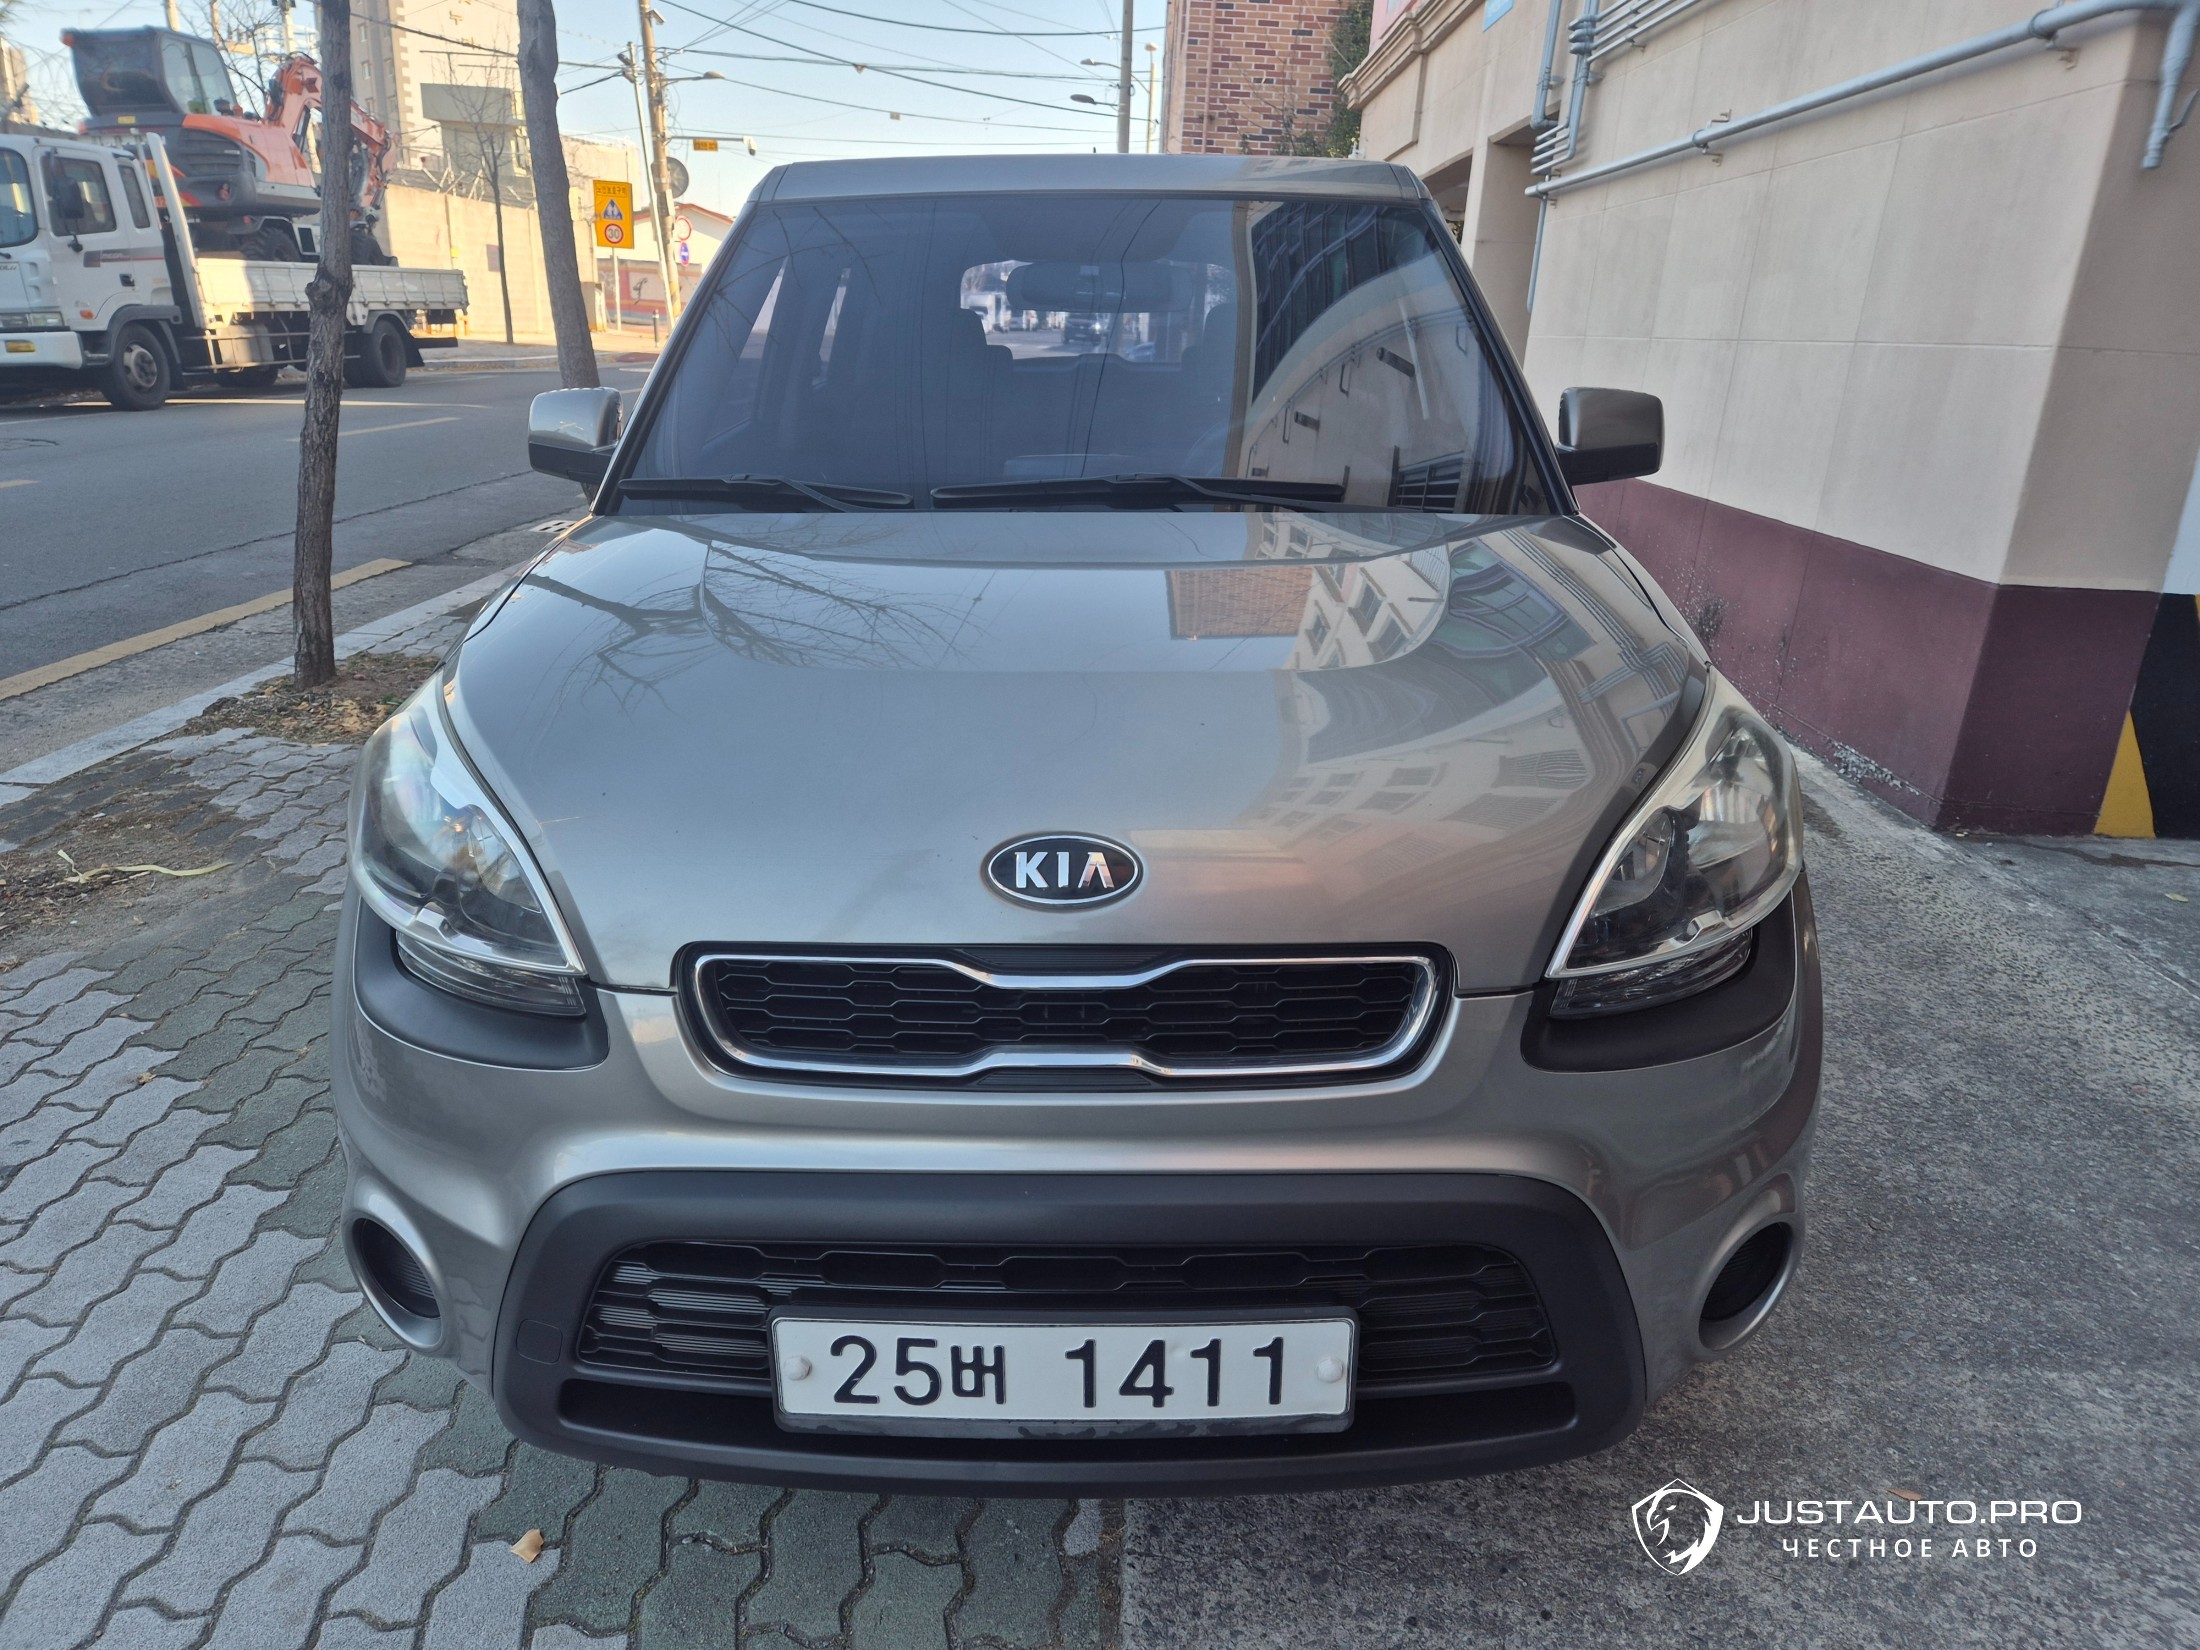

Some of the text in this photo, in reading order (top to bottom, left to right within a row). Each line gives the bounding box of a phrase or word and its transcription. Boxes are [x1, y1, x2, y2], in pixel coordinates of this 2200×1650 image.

[608, 228, 620, 240] 30
[1014, 851, 1115, 889] KIA
[830, 1335, 1286, 1408] 25버 1411
